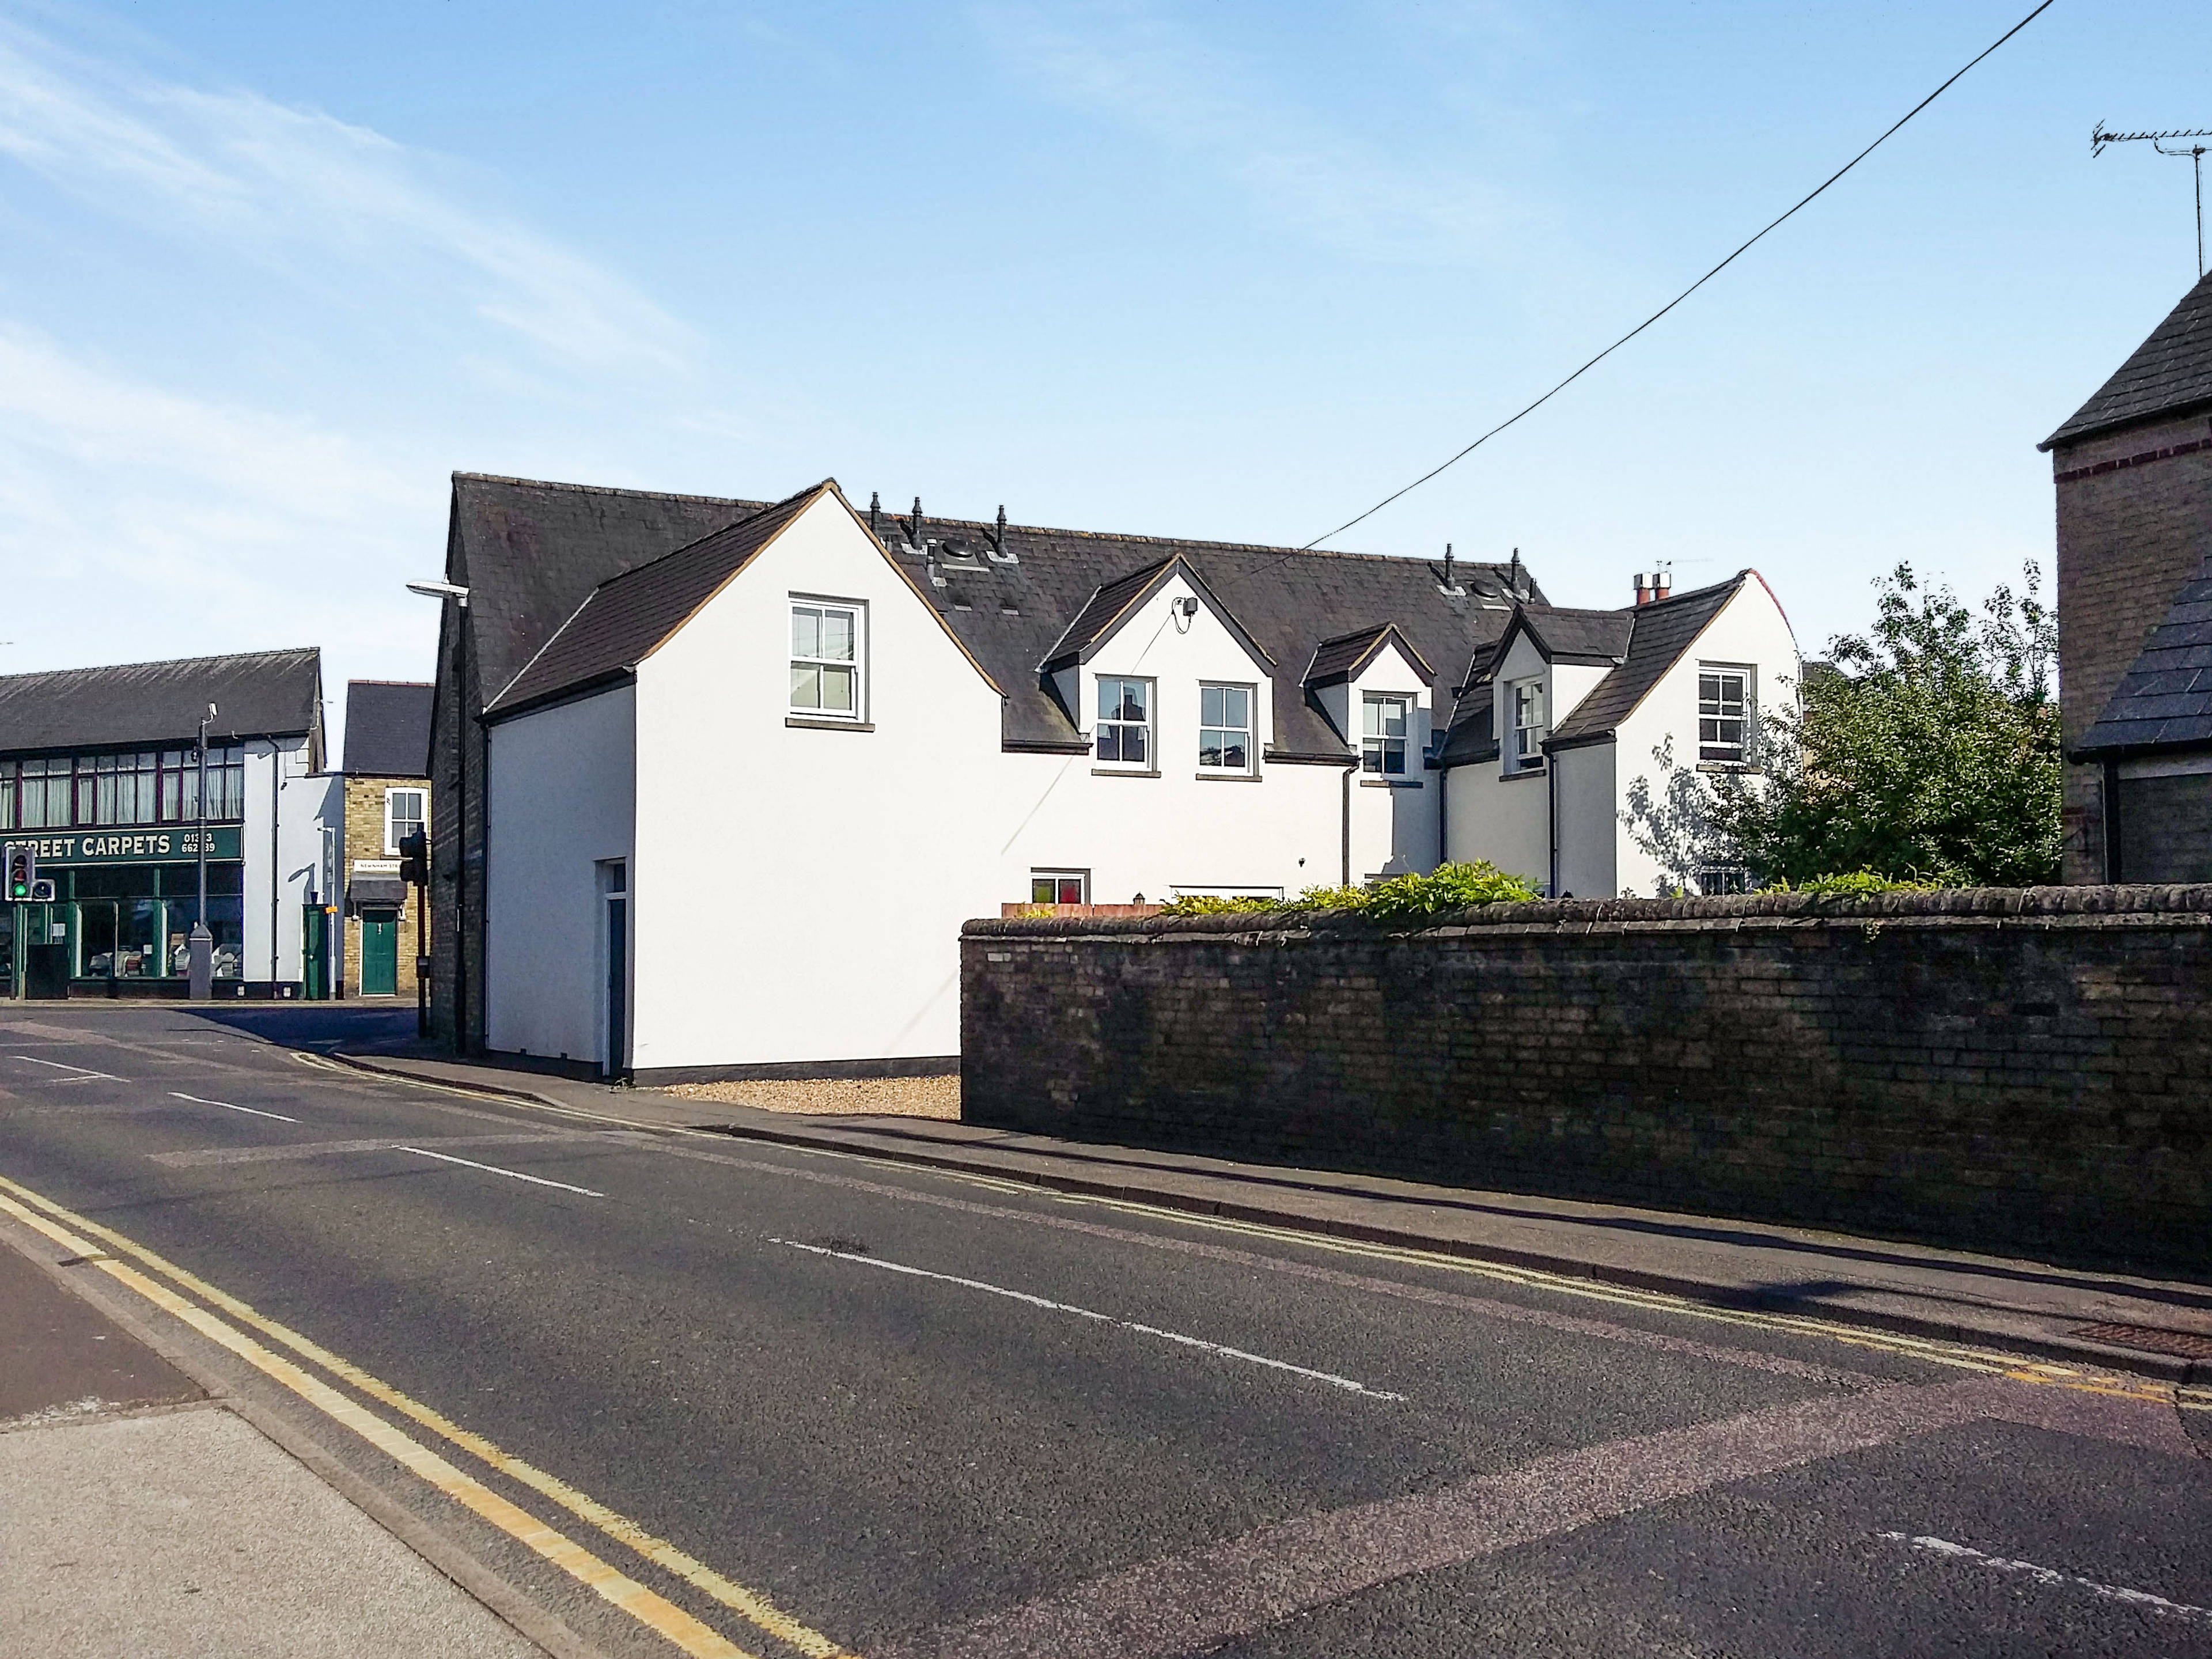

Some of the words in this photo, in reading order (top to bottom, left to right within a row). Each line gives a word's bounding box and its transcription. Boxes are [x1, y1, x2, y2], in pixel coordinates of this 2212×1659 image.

[184, 833, 212, 842] 0133
[82, 835, 171, 855] CARPETS
[181, 843, 215, 853] 66239
